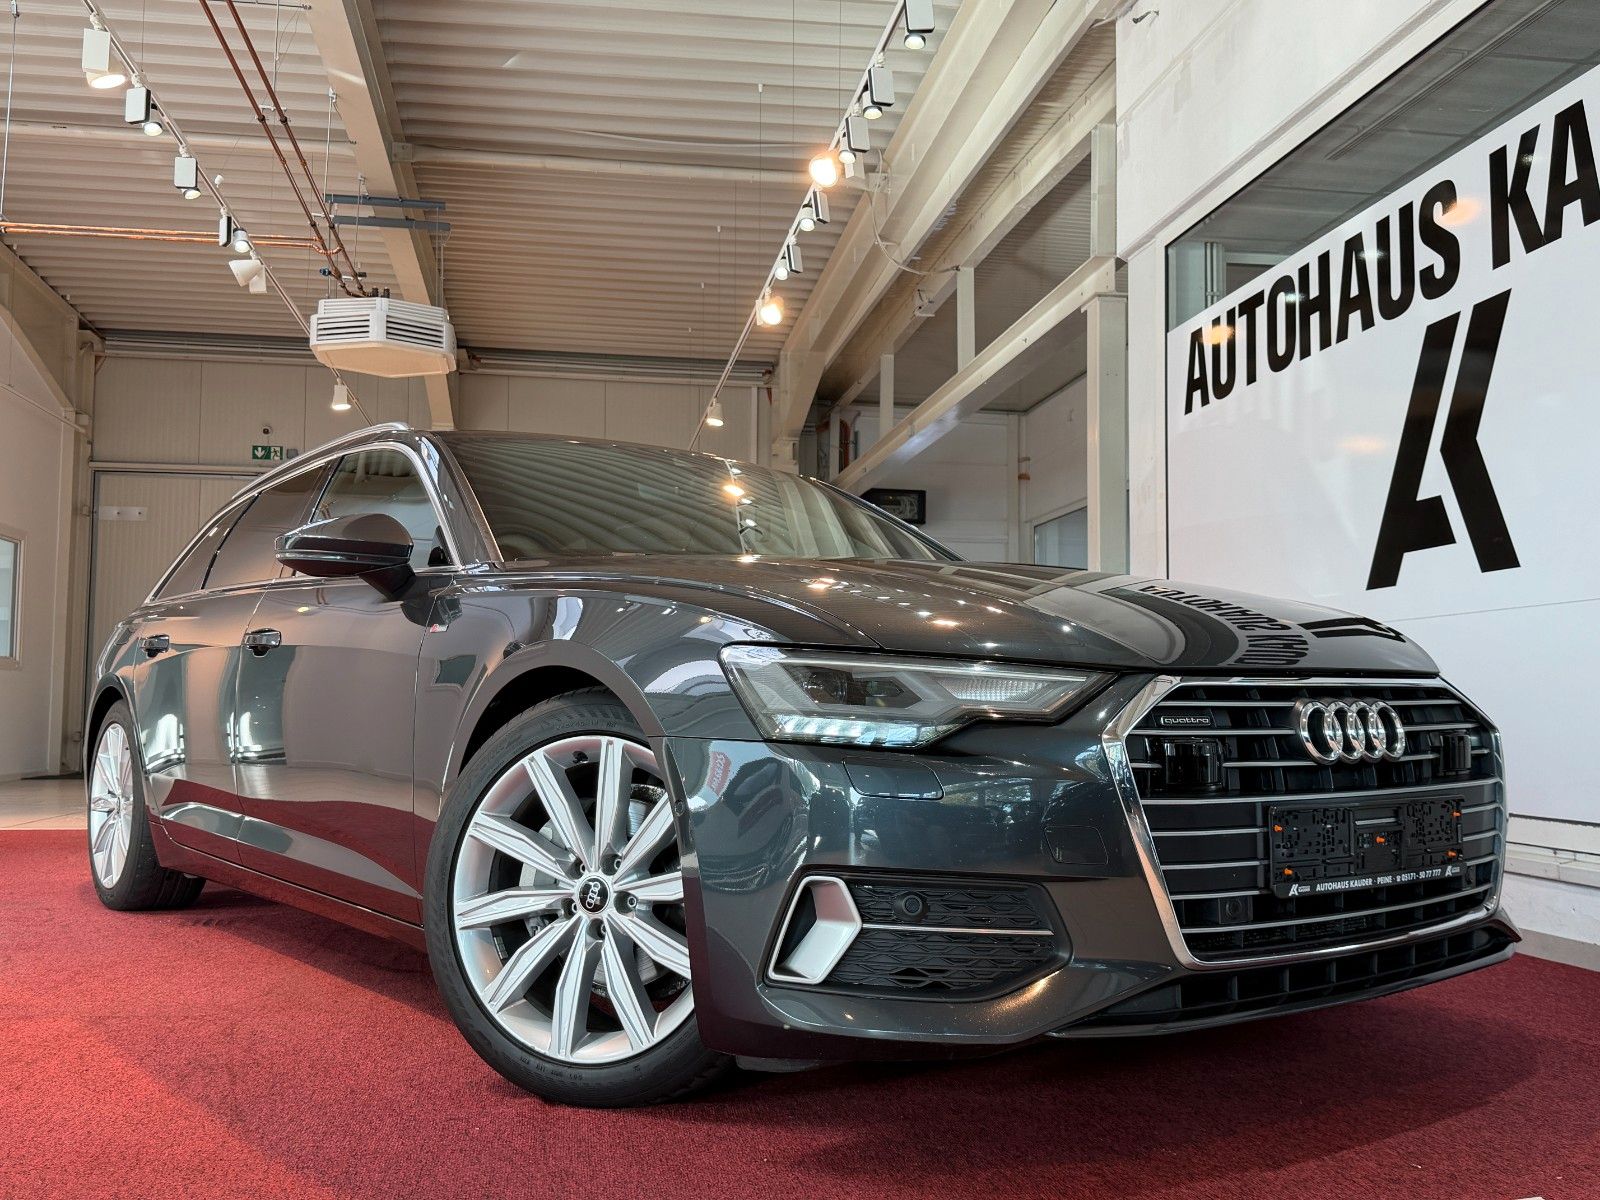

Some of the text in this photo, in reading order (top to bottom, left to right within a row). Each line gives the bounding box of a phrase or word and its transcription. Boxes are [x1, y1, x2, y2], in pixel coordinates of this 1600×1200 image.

[1184, 98, 1600, 416] AUTOHAUS KA
[1164, 716, 1209, 725] quattro
[1315, 880, 1349, 892] AUTOHAUS
[1349, 877, 1373, 888] KAUDER
